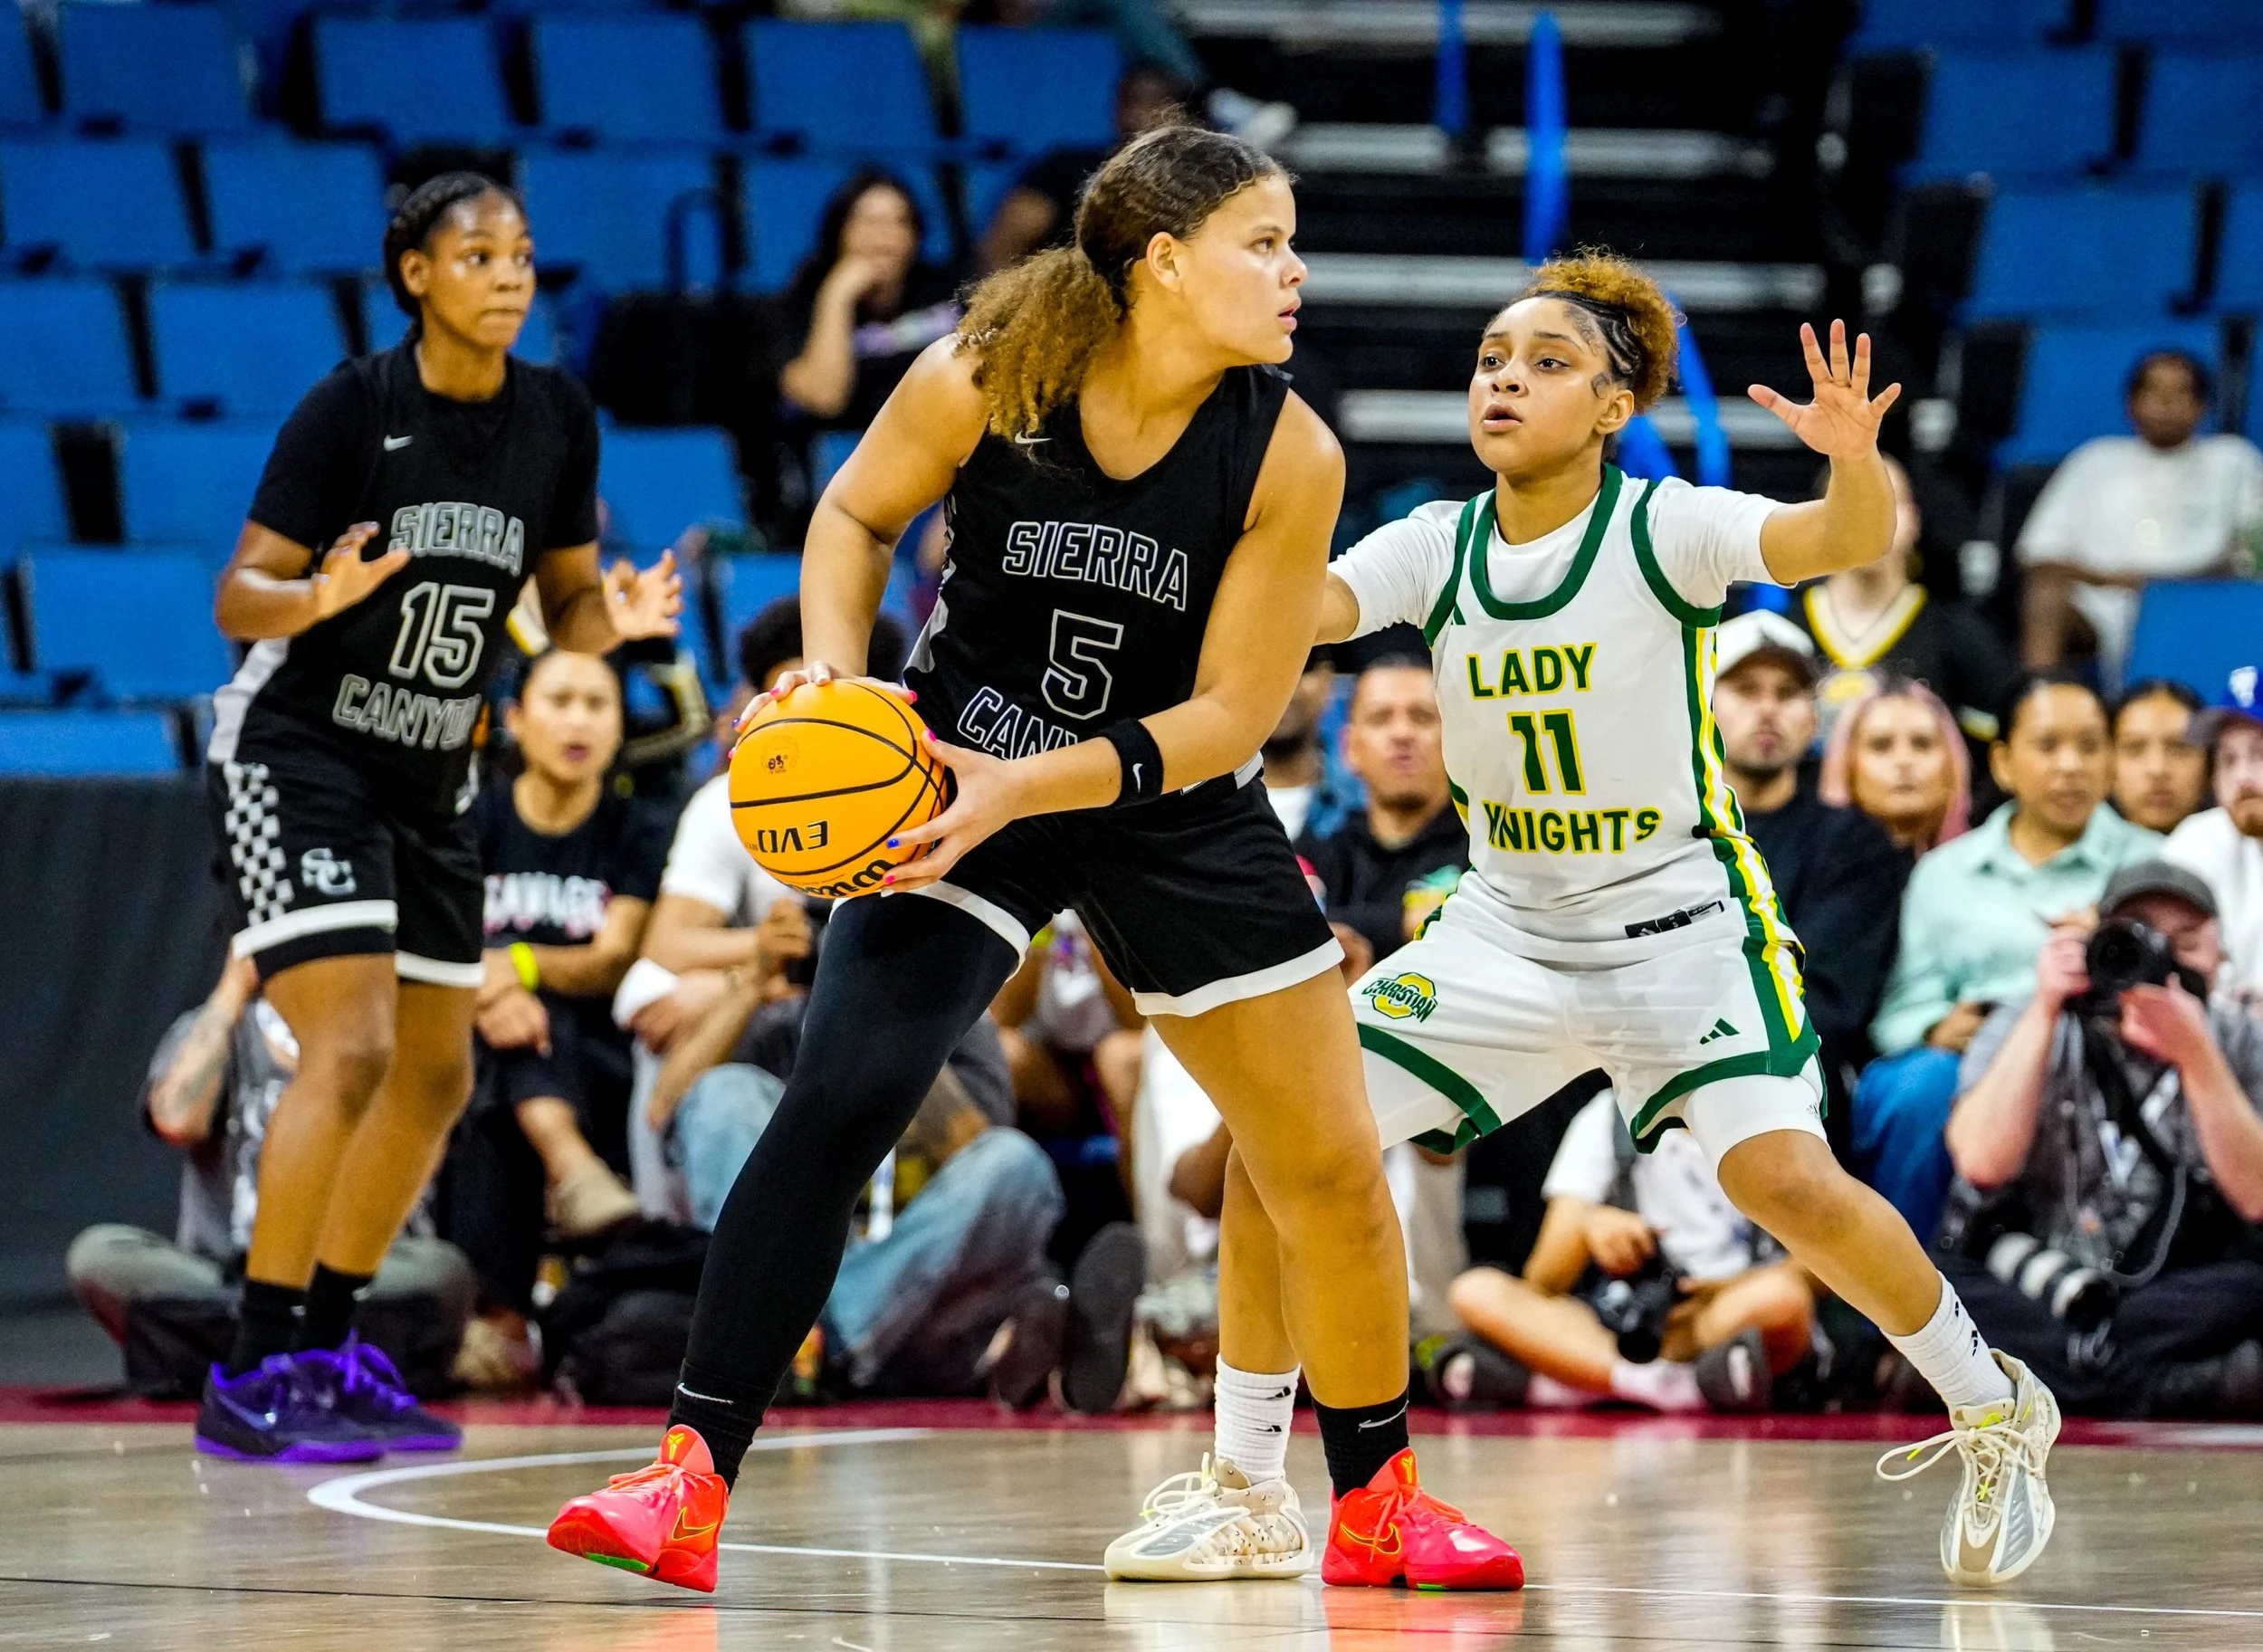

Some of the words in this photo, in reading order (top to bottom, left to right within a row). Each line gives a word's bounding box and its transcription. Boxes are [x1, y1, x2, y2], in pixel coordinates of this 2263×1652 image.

[387, 501, 524, 577] SIERRA
[1002, 521, 1188, 612] SIERRA
[388, 581, 495, 688] 15
[1041, 608, 1124, 720] 5
[1466, 643, 1597, 700] LADY
[1506, 709, 1586, 795] 11
[1361, 979, 1437, 1023] CHRISTIAN
